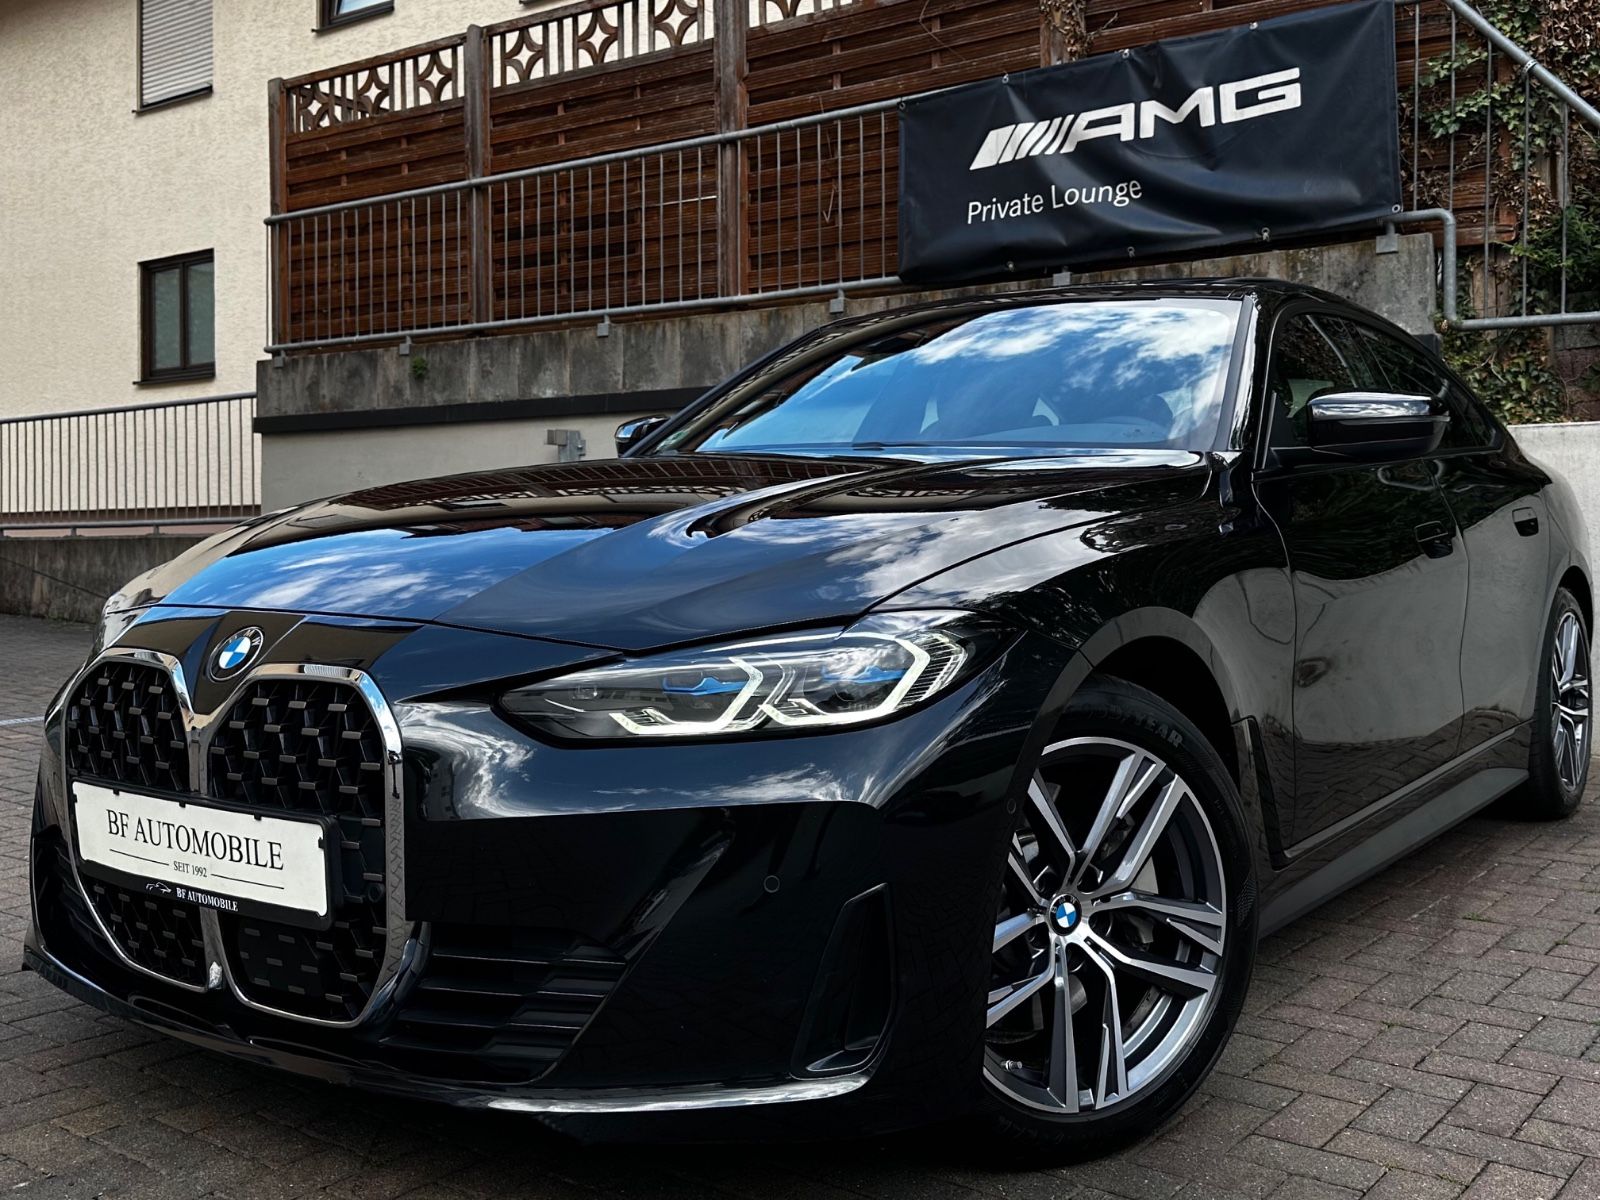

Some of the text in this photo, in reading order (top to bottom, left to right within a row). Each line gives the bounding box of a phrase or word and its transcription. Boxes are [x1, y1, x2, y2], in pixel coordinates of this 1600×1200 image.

[1060, 67, 1302, 154] AMG
[967, 180, 1142, 224] Private Lounge
[106, 809, 284, 870] BF AUTOMOBILE
[173, 860, 208, 878] SEIT 1992
[176, 887, 239, 912] BF AUTOMOBILE
